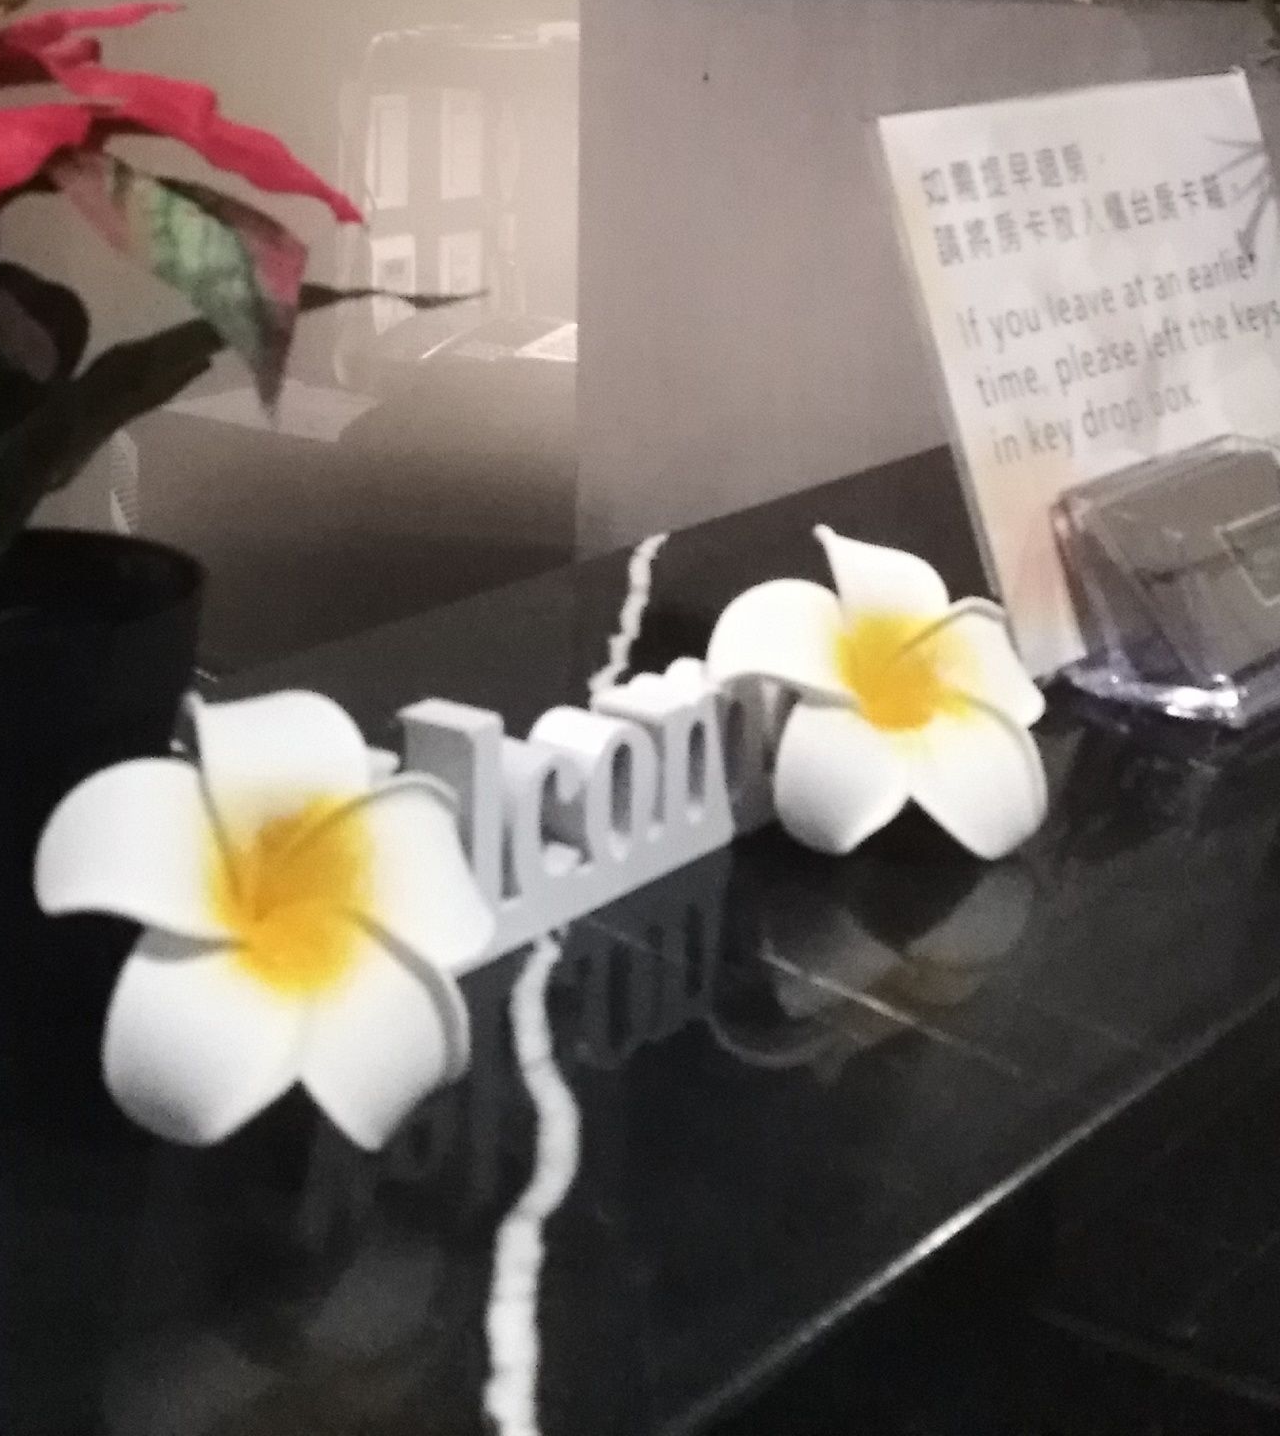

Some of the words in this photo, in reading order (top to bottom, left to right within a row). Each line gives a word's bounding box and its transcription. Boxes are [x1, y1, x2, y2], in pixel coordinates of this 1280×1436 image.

[955, 307, 983, 349] If
[986, 305, 1042, 355] you
[1045, 285, 1117, 327] leave
[1123, 274, 1148, 309] at
[1154, 271, 1183, 302] an
[1054, 337, 1139, 397] please
[1141, 315, 1188, 362] left
[1187, 311, 1229, 347] the
[989, 428, 1021, 466] in
[1023, 417, 1075, 459] key
[1080, 399, 1153, 442] drop
